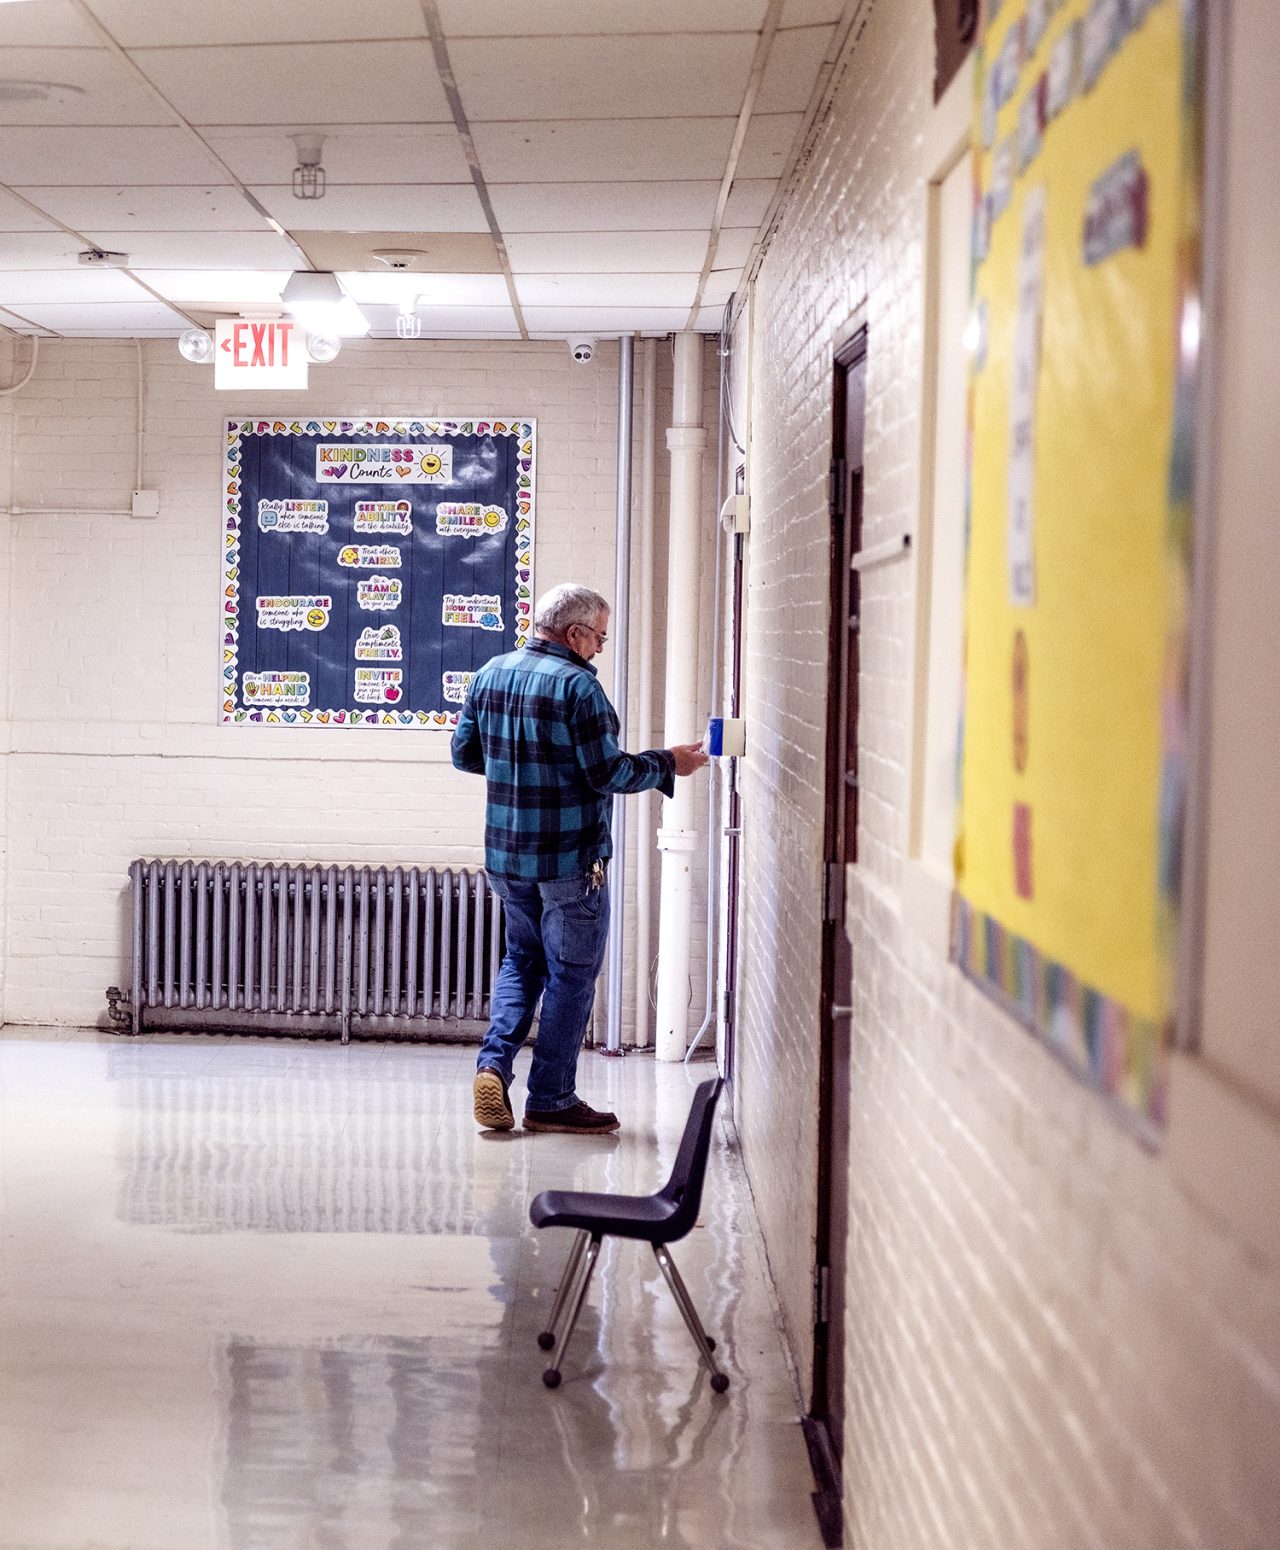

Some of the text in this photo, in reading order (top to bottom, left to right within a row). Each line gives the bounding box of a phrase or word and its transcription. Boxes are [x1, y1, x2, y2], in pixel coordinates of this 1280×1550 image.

[233, 323, 294, 367] EXIT
[320, 448, 414, 462] KINDNESS
[349, 463, 393, 479] Counts
[261, 501, 326, 513] Really LISTEN
[439, 504, 481, 515] SHARE
[280, 511, 295, 520] when
[278, 521, 292, 529] else
[439, 516, 482, 526] SMILES
[439, 525, 451, 533] with
[361, 584, 389, 592] TEAM
[360, 593, 399, 601] PLAYER
[445, 596, 456, 605] Try
[467, 596, 498, 605] understand
[259, 598, 329, 608] ENCOURAGE
[292, 608, 304, 617] who
[467, 605, 499, 613] OTHERS
[444, 612, 480, 623] FEEL.
[363, 630, 380, 640] Give
[358, 641, 398, 649] compliments
[263, 673, 307, 682] HELPING
[357, 670, 400, 681] INVITE
[446, 674, 471, 684] SHA
[260, 683, 308, 696] HAND
